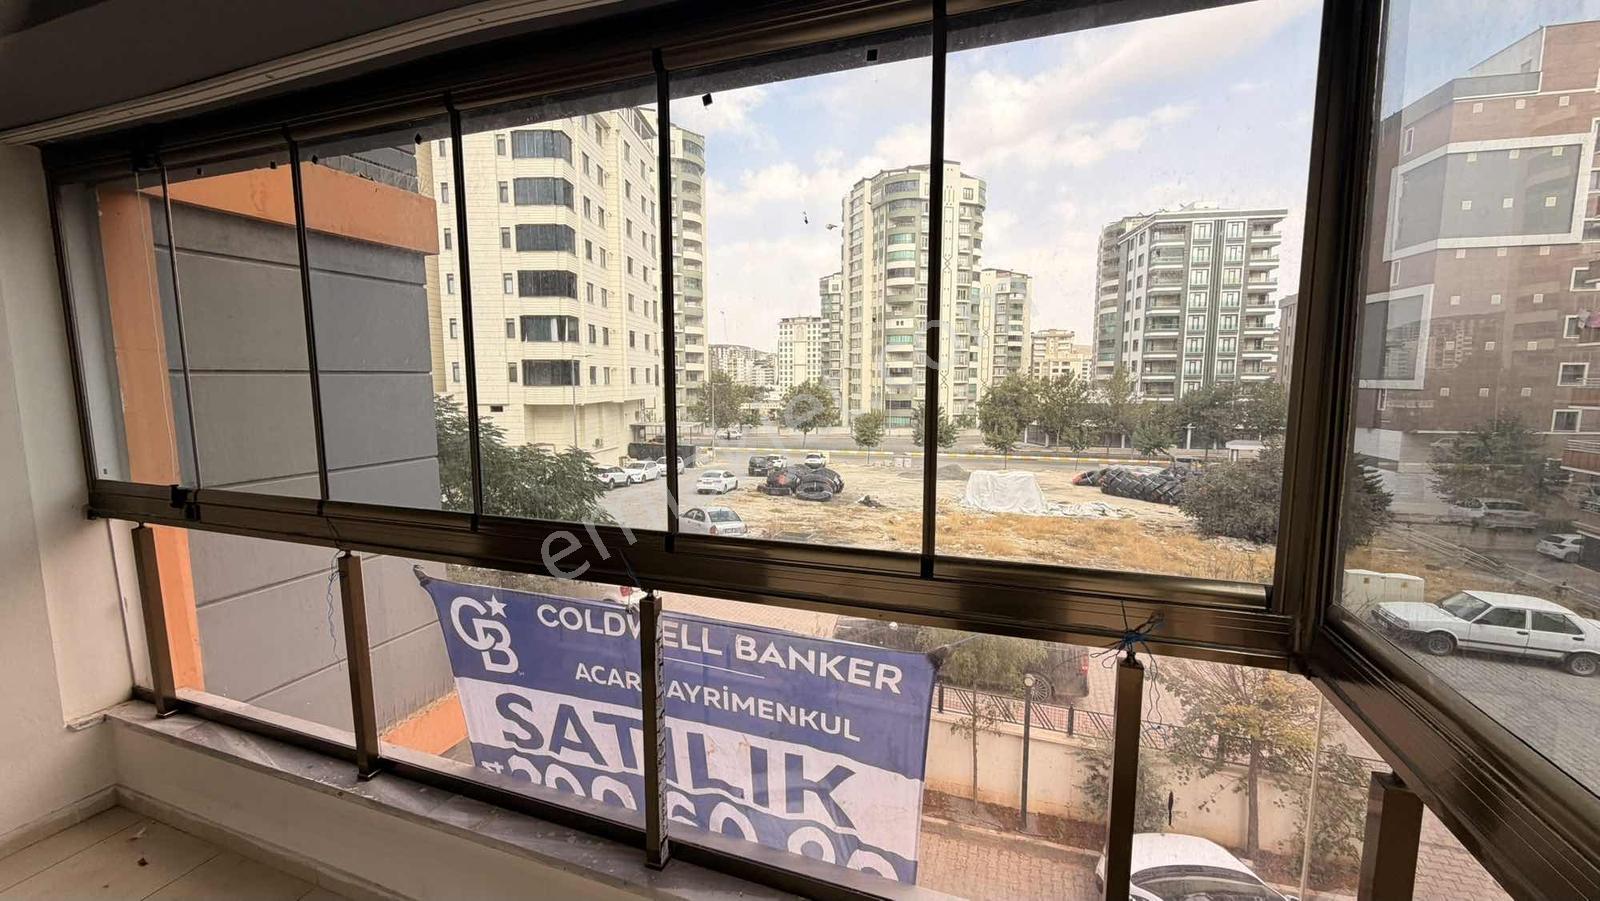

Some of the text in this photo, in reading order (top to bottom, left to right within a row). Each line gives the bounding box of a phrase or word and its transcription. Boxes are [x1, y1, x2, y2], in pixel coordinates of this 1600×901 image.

[576, 662, 861, 743] ACAR AYRİMENKUL
[735, 634, 903, 695] BANKER
[495, 692, 858, 831] SATILIK
